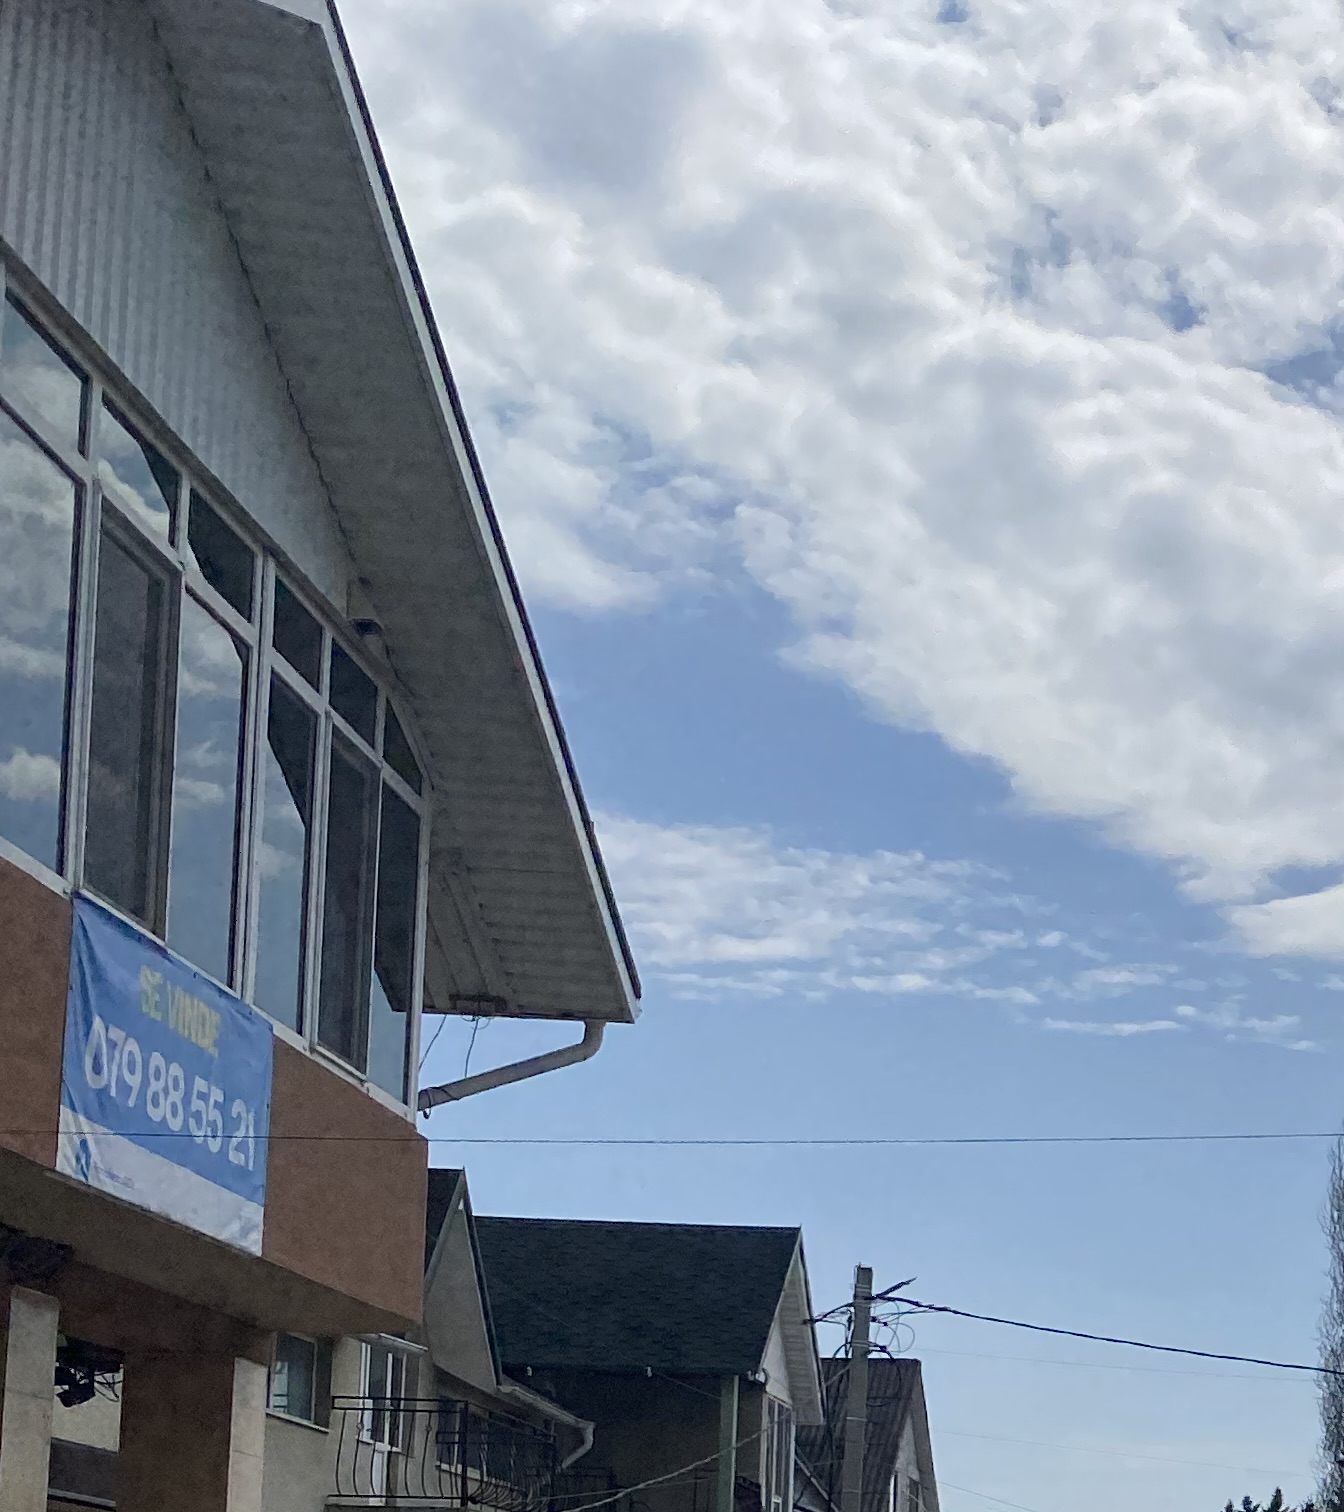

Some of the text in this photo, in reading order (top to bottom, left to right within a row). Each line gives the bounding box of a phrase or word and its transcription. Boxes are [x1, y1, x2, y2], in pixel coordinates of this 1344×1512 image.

[85, 1015, 255, 1171] 079 88 55 21
